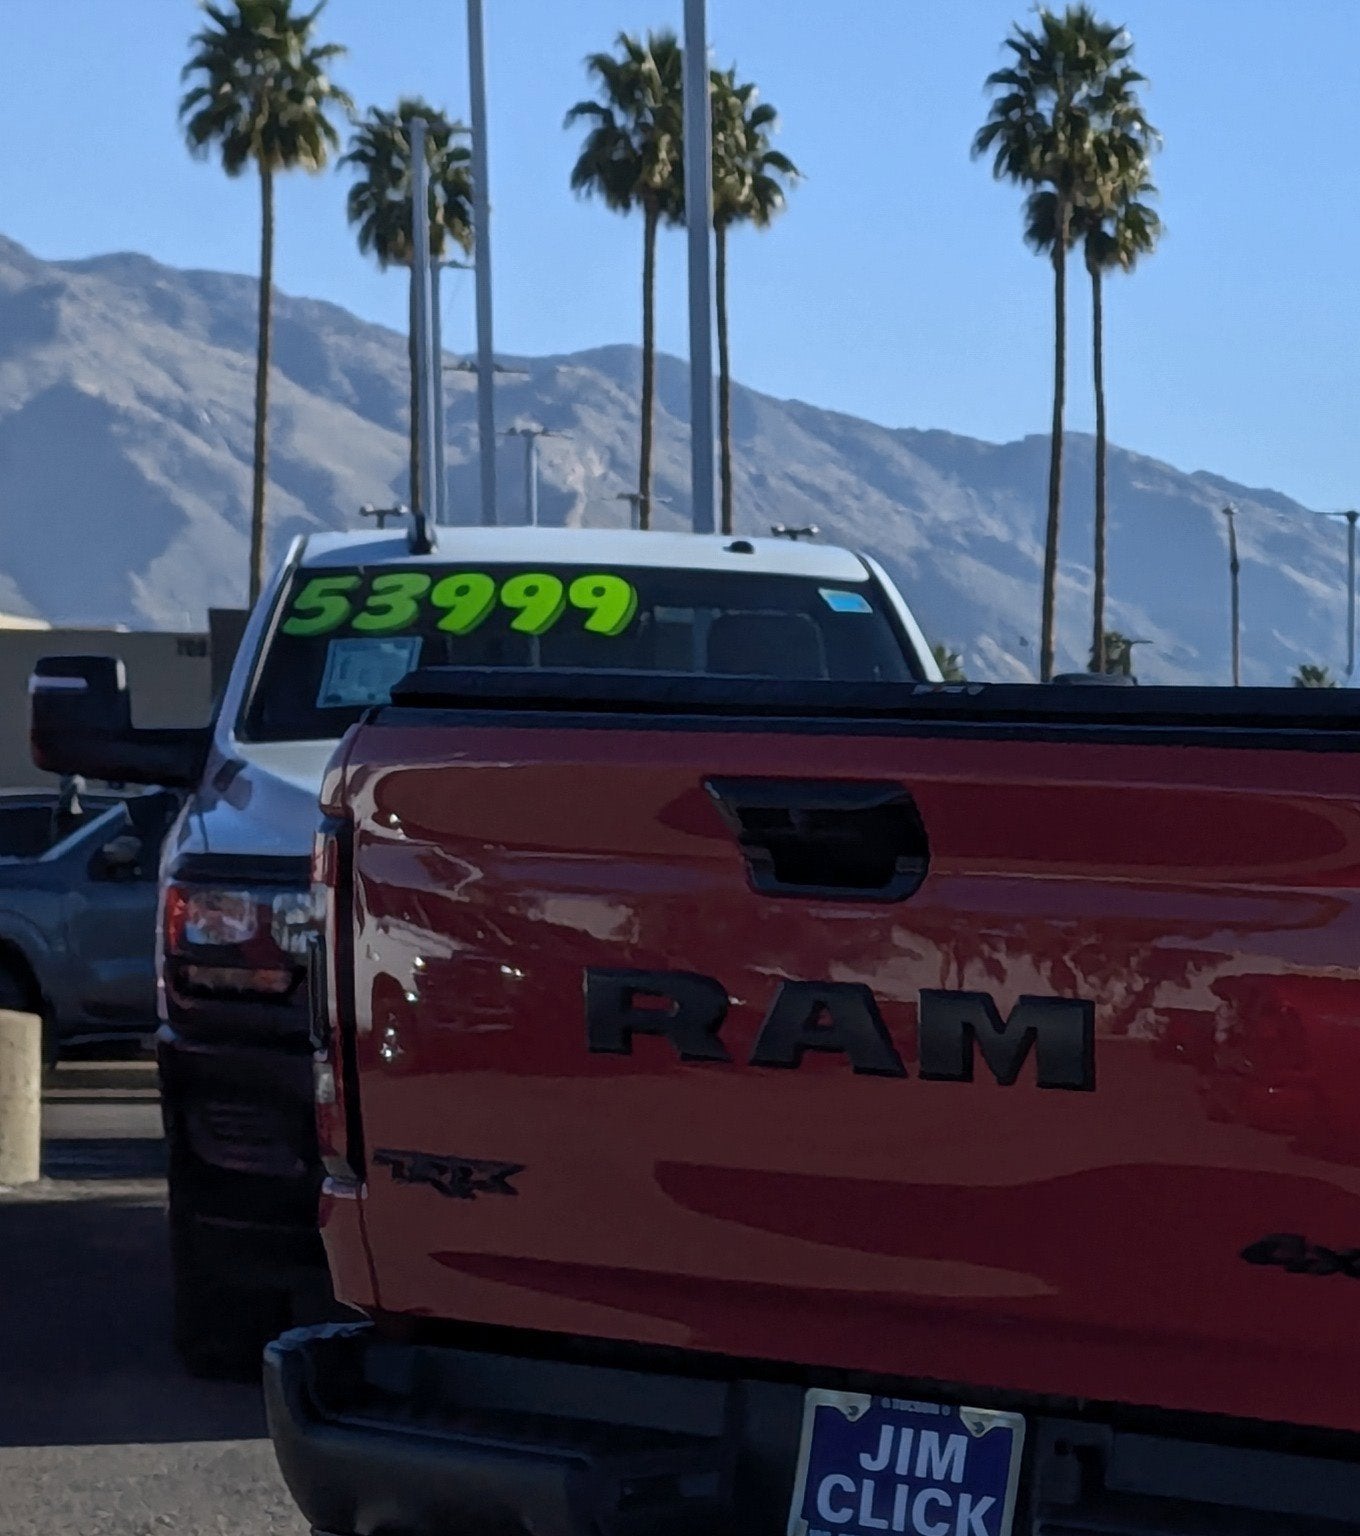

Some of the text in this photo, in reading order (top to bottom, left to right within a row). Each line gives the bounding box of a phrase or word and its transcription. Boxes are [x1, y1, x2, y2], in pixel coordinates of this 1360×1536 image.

[283, 572, 638, 637] 53999
[583, 967, 1097, 1093] RAM
[373, 1148, 526, 1201] TRX
[859, 1424, 968, 1483] JIM
